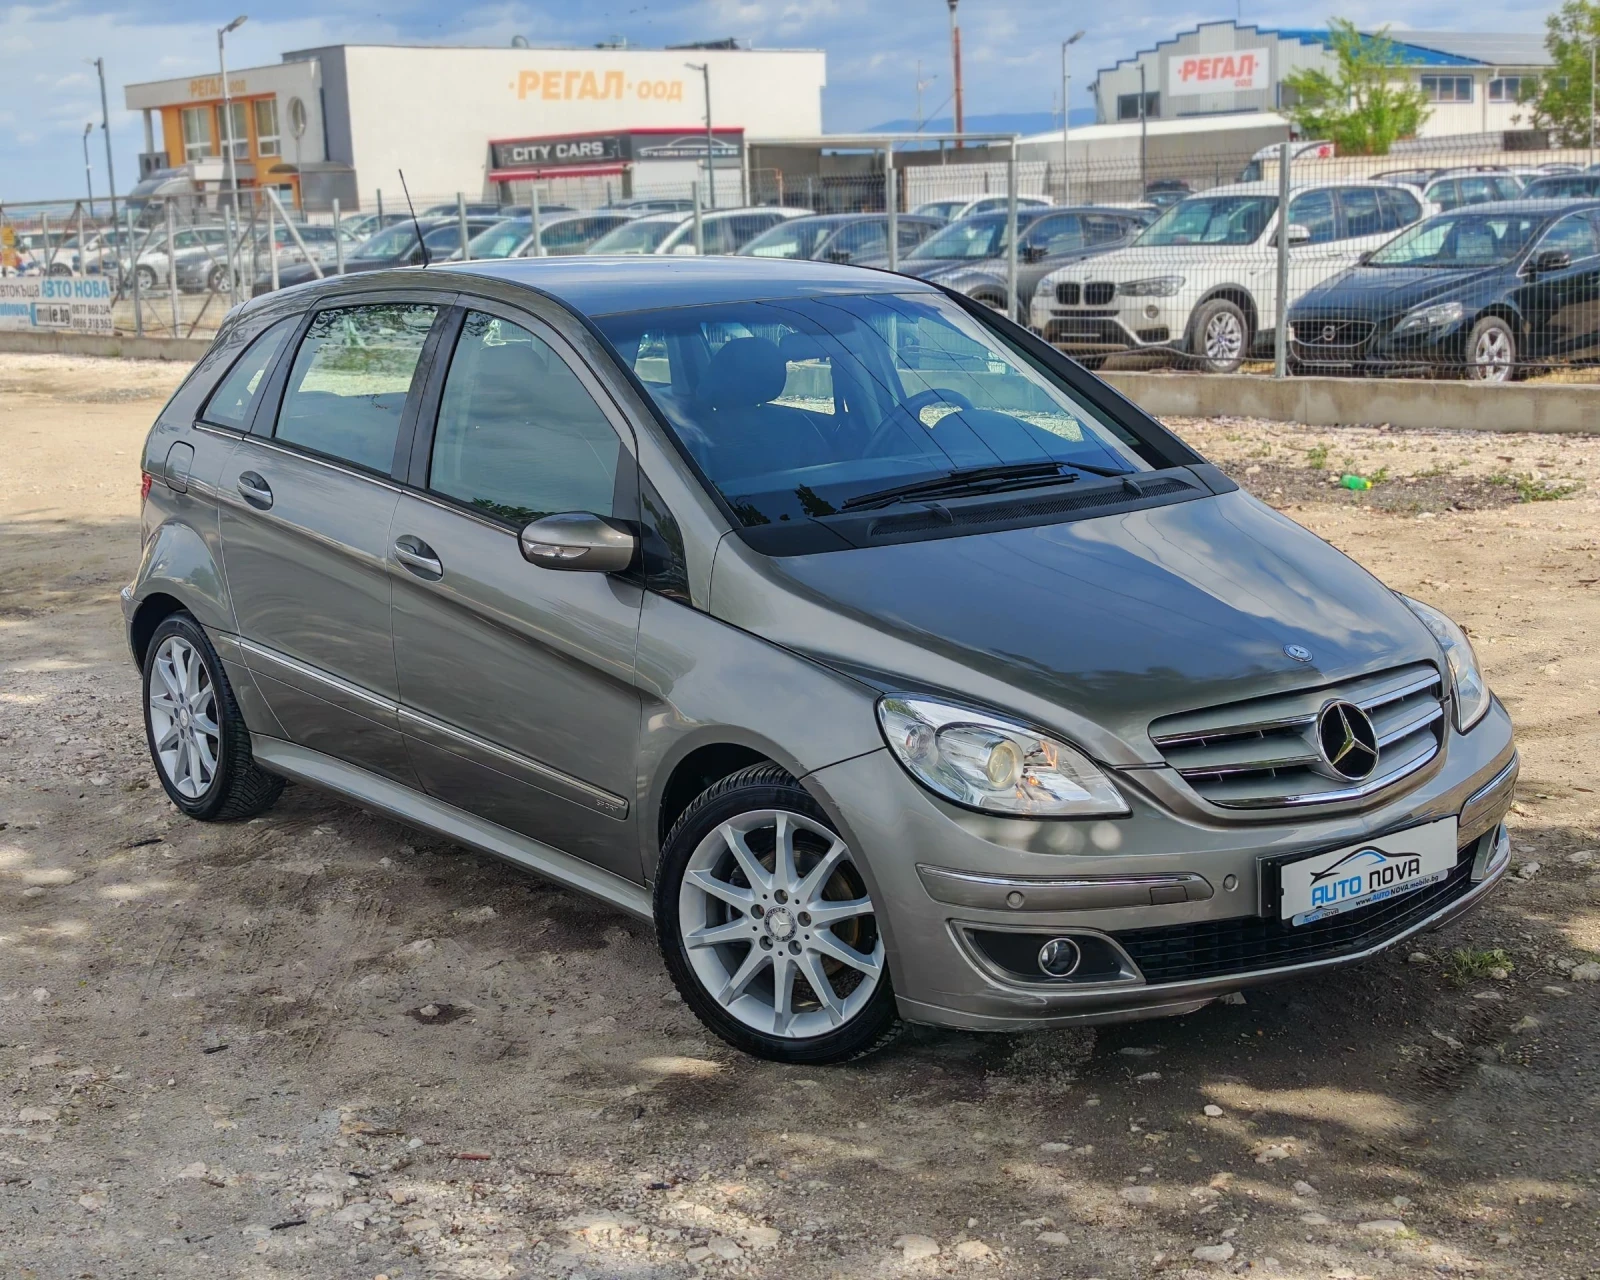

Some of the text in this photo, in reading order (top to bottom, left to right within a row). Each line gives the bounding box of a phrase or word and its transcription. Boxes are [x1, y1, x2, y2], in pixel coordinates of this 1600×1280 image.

[1182, 55, 1255, 81] РЕГАЛ
[517, 71, 625, 100] РЕГАЛ
[513, 141, 604, 161] CITY CARS
[41, 280, 72, 298] АВТО
[74, 280, 110, 298] НОВА
[1311, 875, 1362, 907] AUTO
